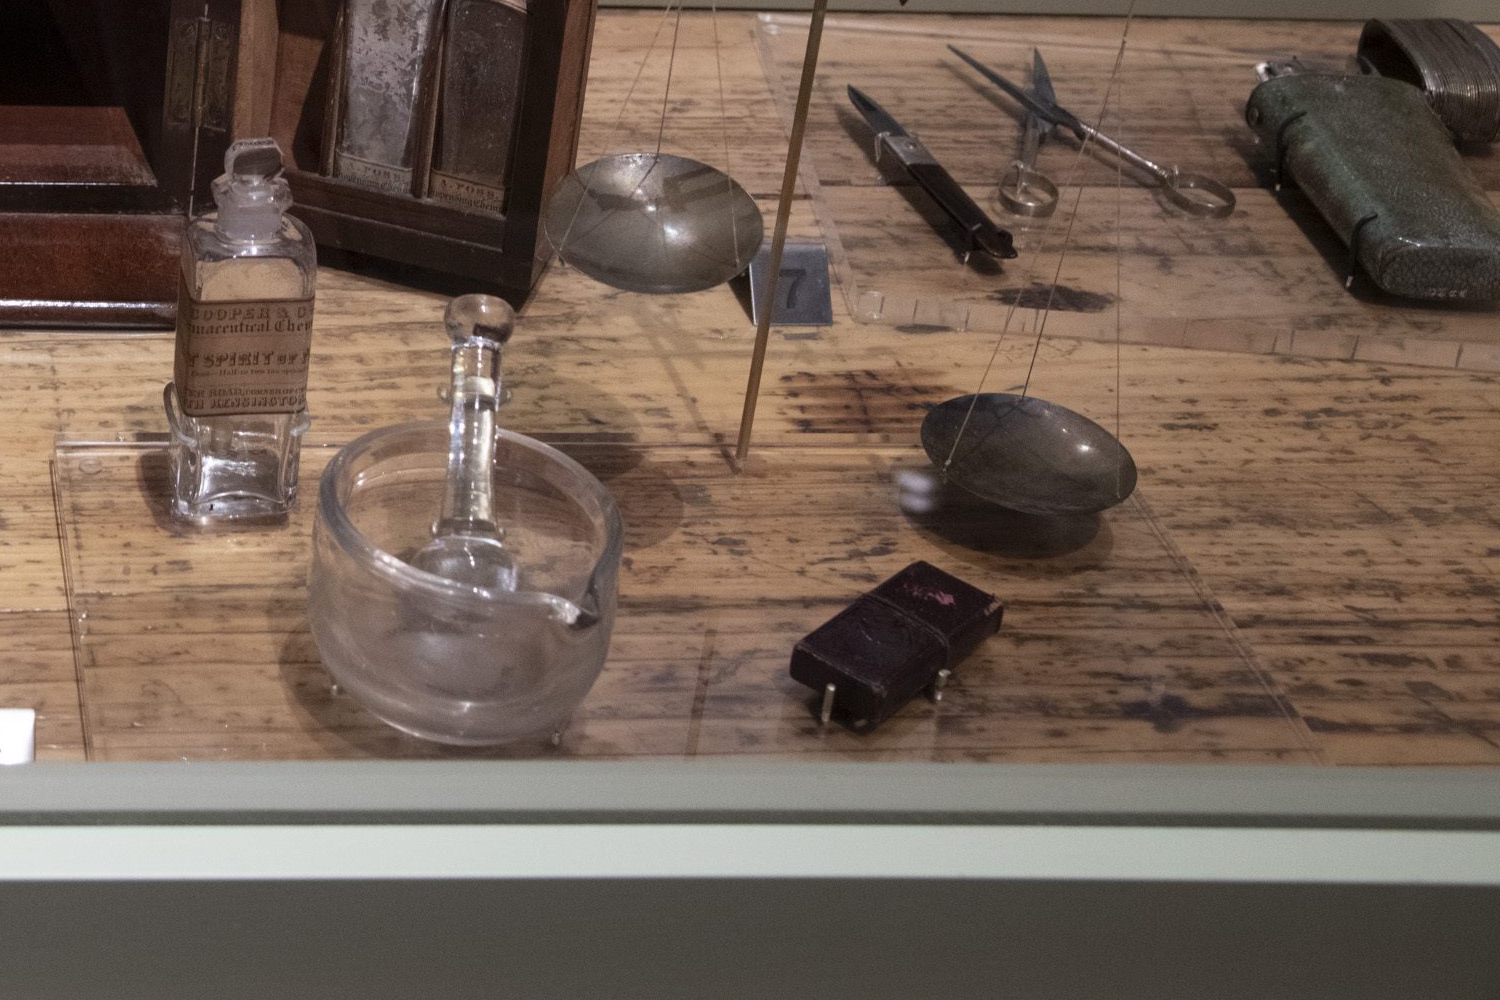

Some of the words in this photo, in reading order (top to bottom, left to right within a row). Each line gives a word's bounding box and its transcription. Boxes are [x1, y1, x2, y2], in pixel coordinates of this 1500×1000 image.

[779, 268, 806, 309] 7
[190, 307, 270, 321] COOPER
[203, 351, 274, 369] SPIRIT
